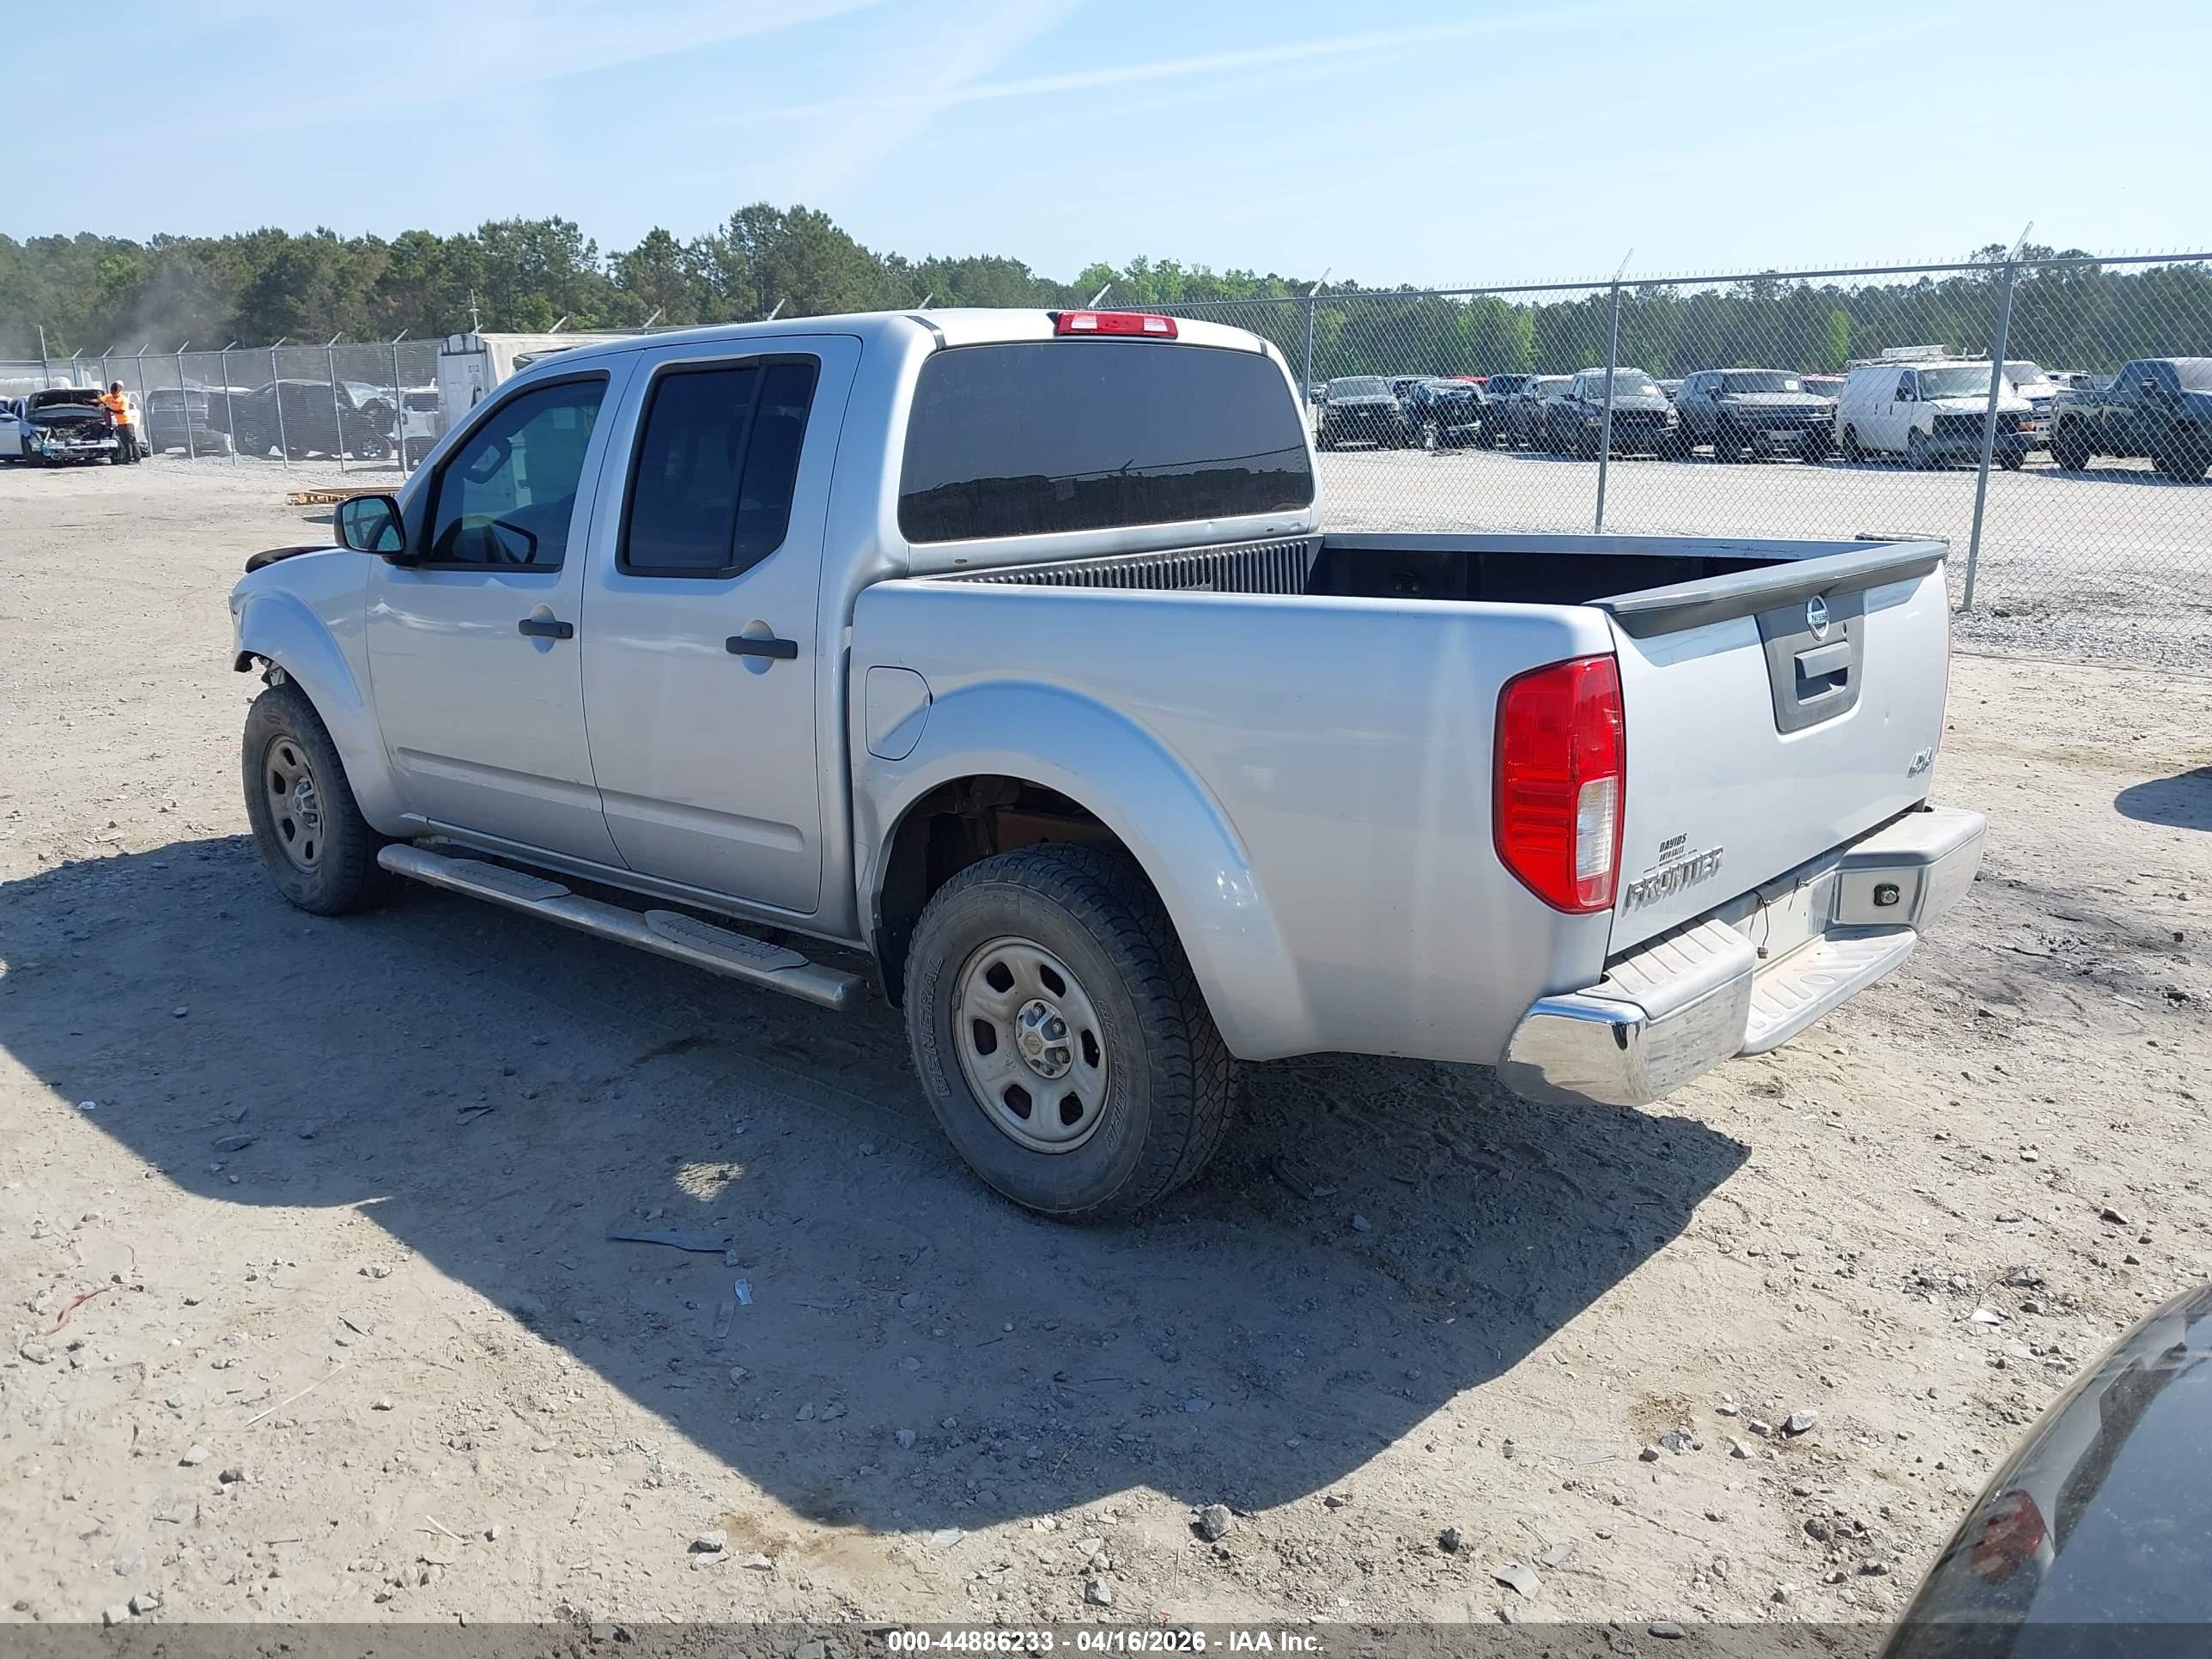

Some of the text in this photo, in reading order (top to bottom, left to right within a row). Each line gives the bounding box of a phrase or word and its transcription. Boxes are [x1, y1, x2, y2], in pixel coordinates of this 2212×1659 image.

[1659, 833, 1687, 853] DAVIDS
[1671, 845, 1685, 857] SALES
[1625, 845, 1724, 912] FRONTIER
[919, 957, 951, 1097] GENERAL
